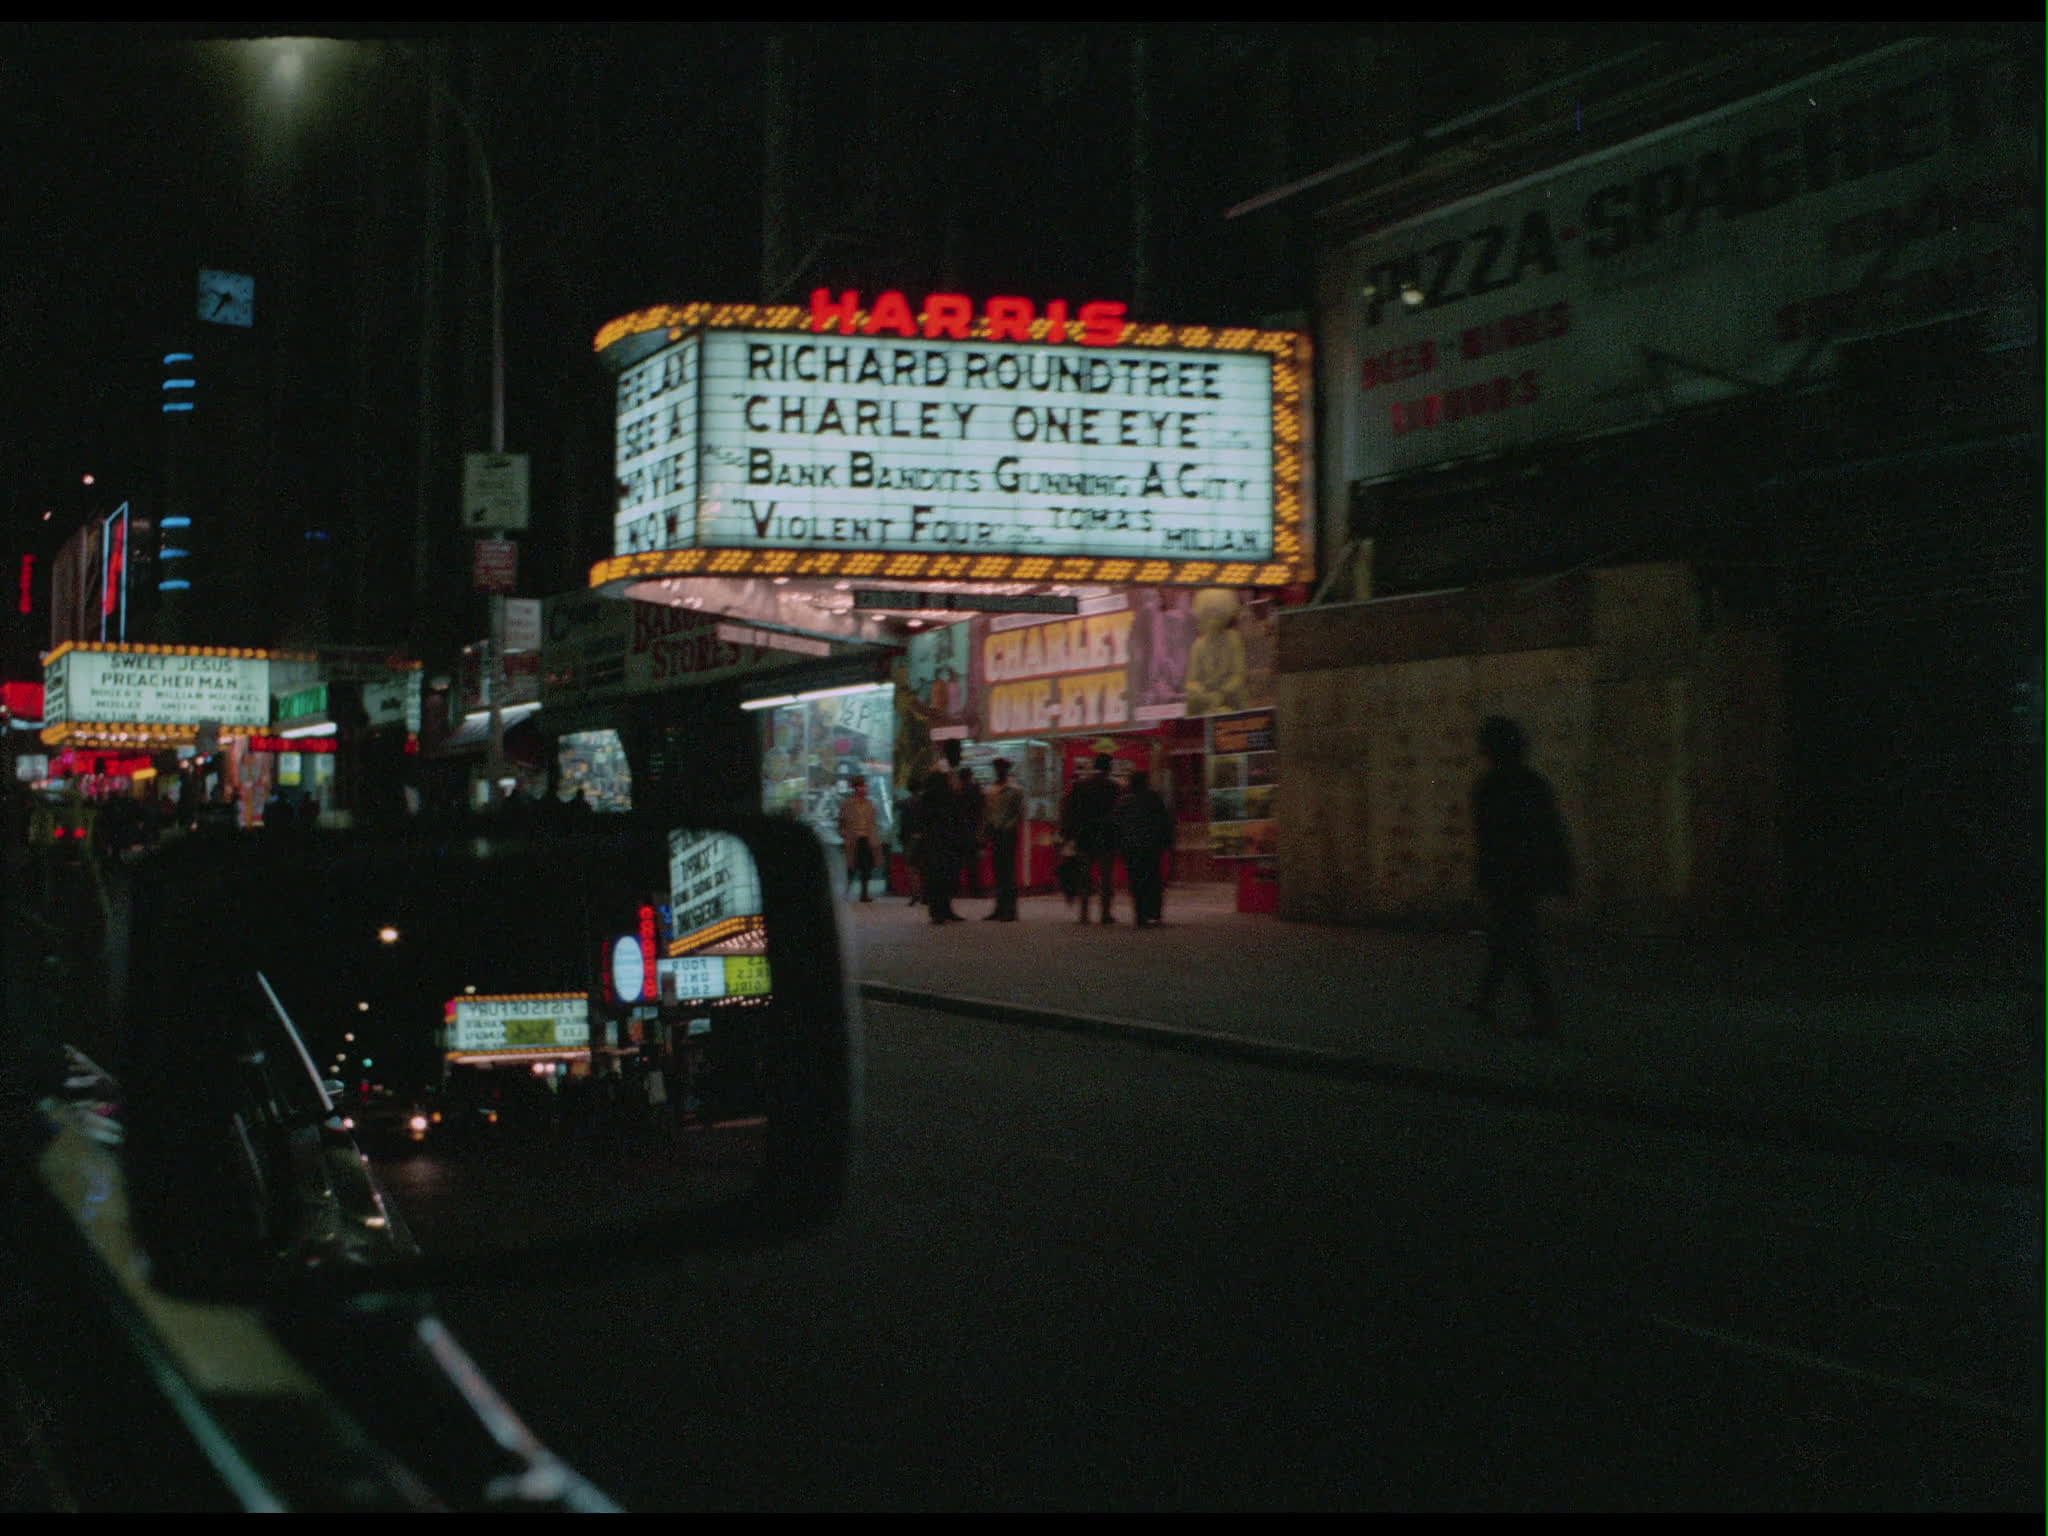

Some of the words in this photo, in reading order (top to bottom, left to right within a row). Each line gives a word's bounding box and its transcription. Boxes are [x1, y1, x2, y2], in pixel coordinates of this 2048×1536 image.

[810, 287, 1128, 346] HARRIS
[748, 343, 949, 388] RICHARD
[966, 352, 1220, 400] ROUNDTREE
[667, 405, 684, 441] A
[1012, 405, 1099, 445] ONE
[747, 447, 838, 488] BANK
[850, 450, 981, 493] BANDITS
[1140, 461, 1168, 498] A
[1176, 462, 1249, 502] CITY
[177, 657, 233, 673] JESUS
[984, 611, 1136, 683] CHARLEY
[989, 671, 1129, 735] ONE-EYE
